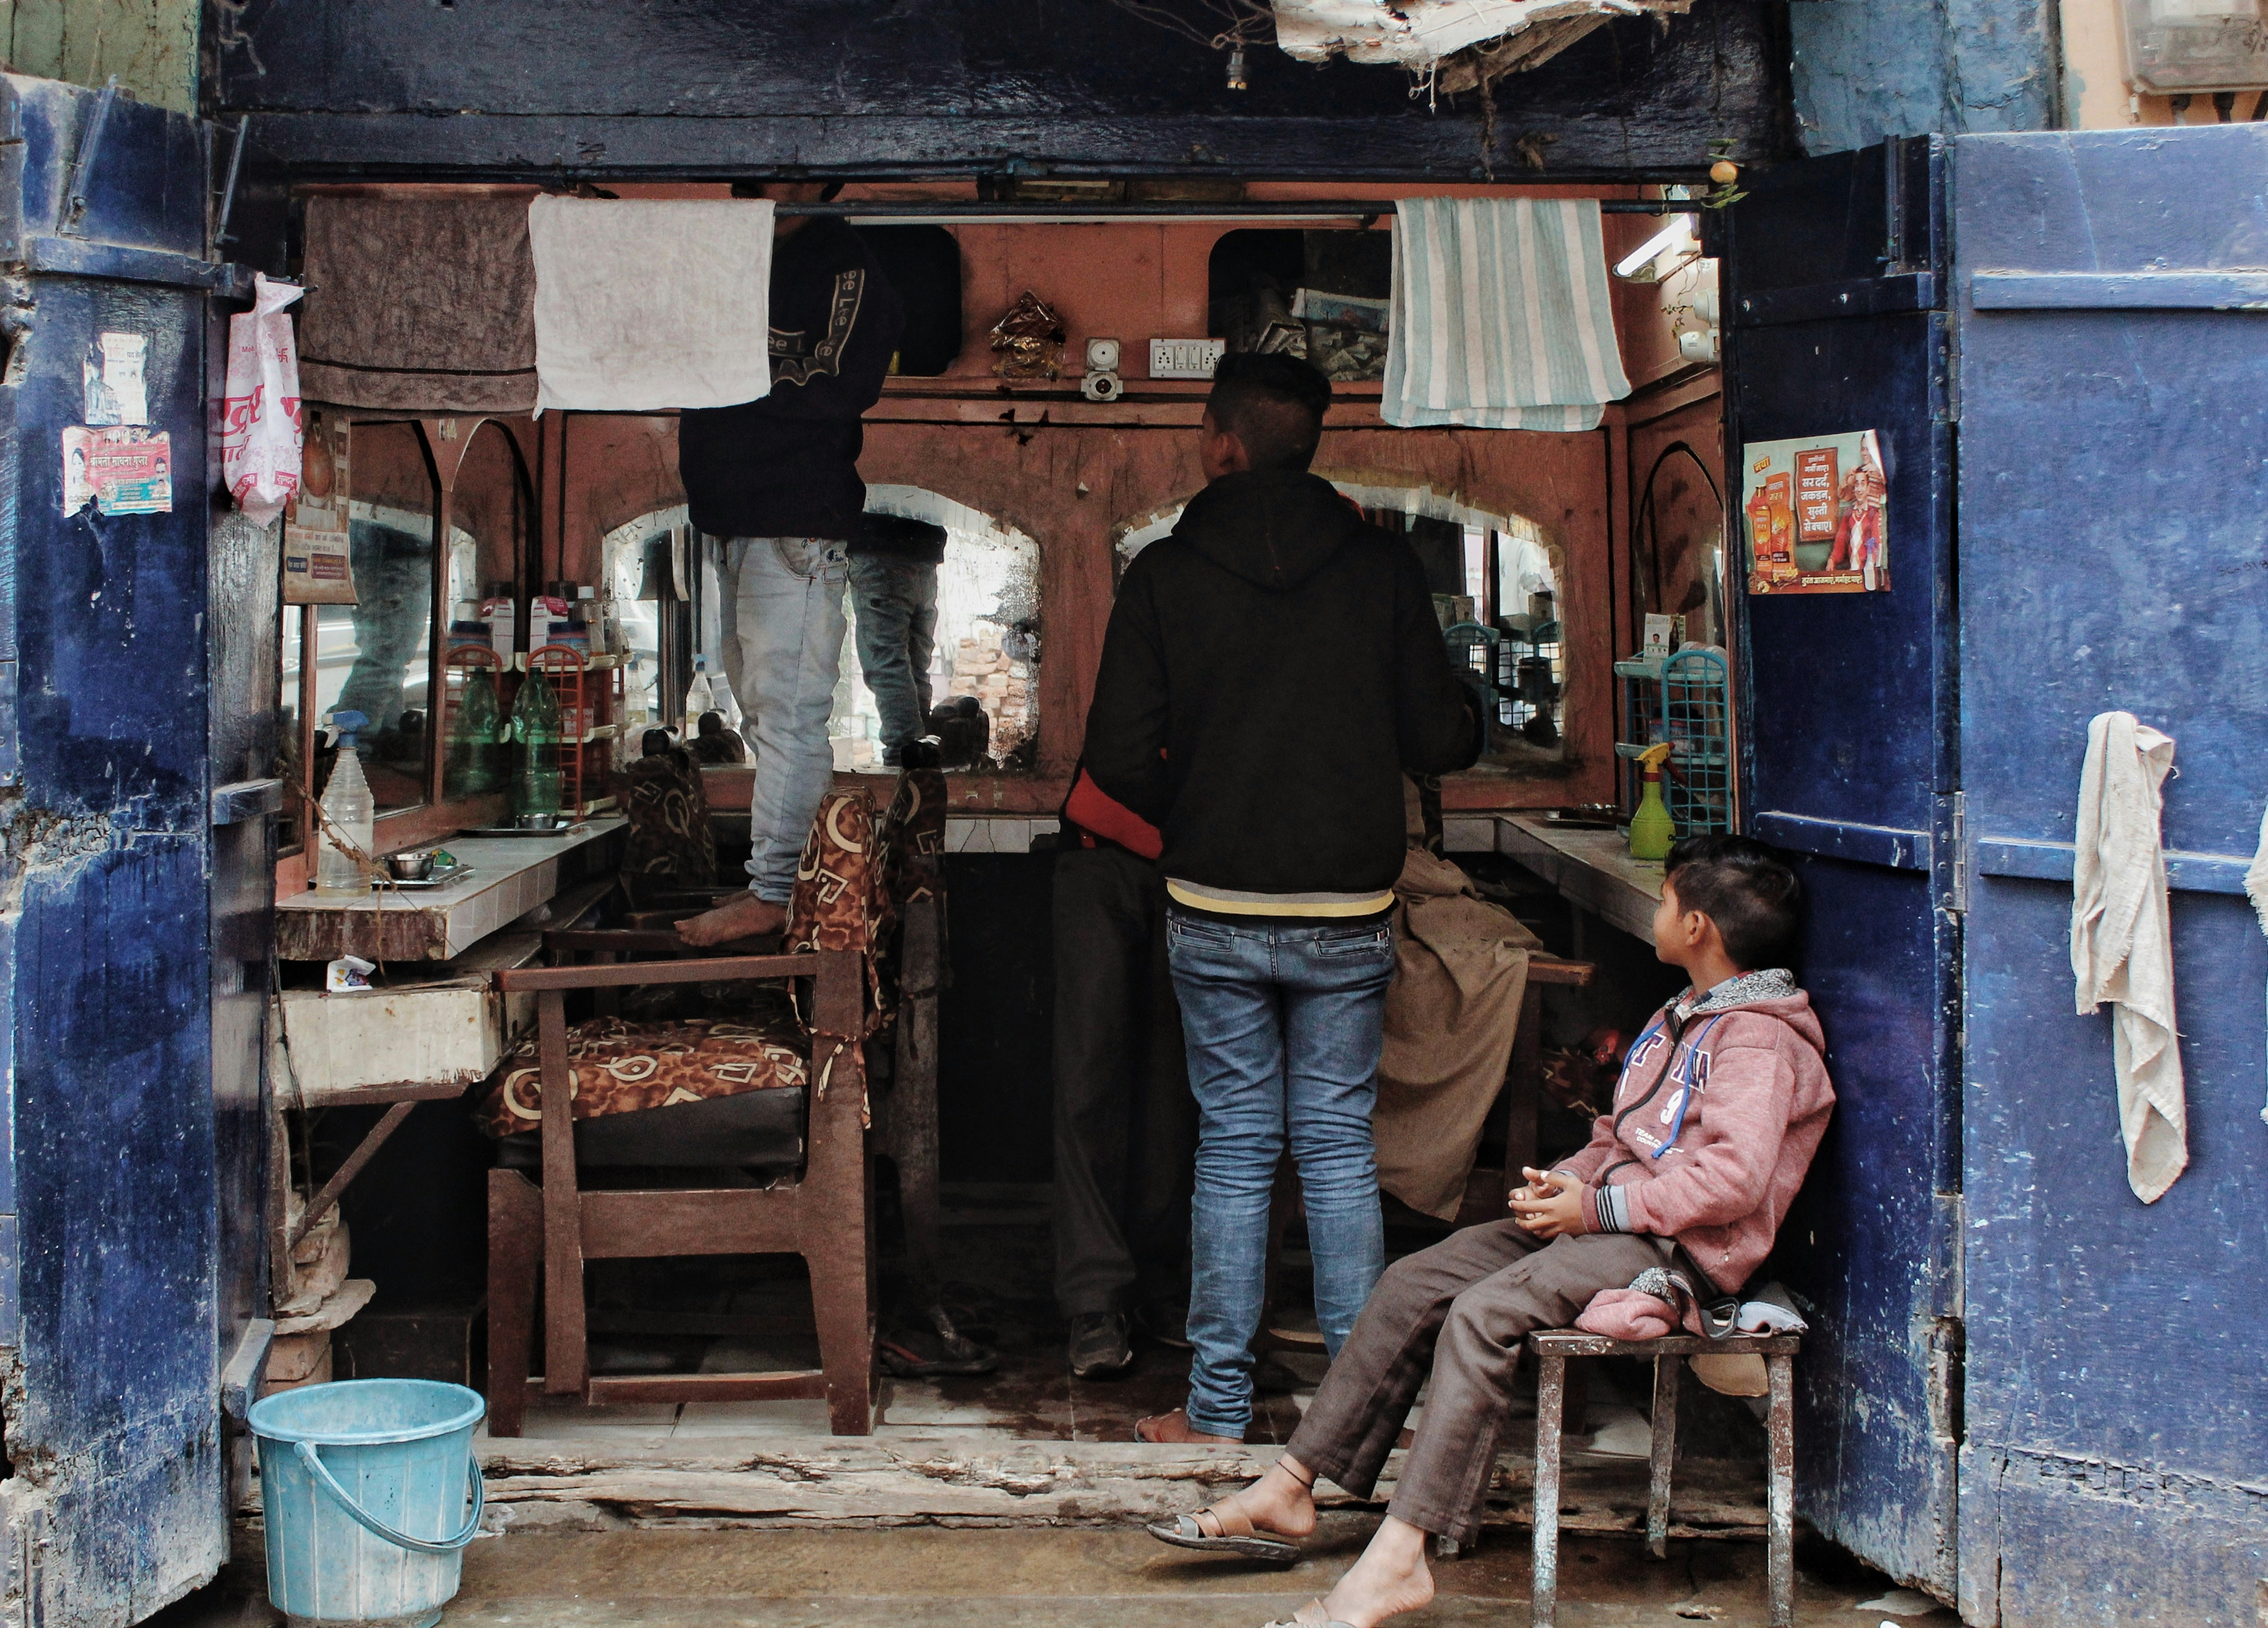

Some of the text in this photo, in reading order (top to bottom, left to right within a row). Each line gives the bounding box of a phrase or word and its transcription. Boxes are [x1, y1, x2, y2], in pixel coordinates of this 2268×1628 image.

[1802, 478, 1814, 487] सर
[1807, 502, 1828, 519] सुस्ती
[1803, 519, 1811, 532] से
[1635, 1127, 1655, 1141] TEAM
